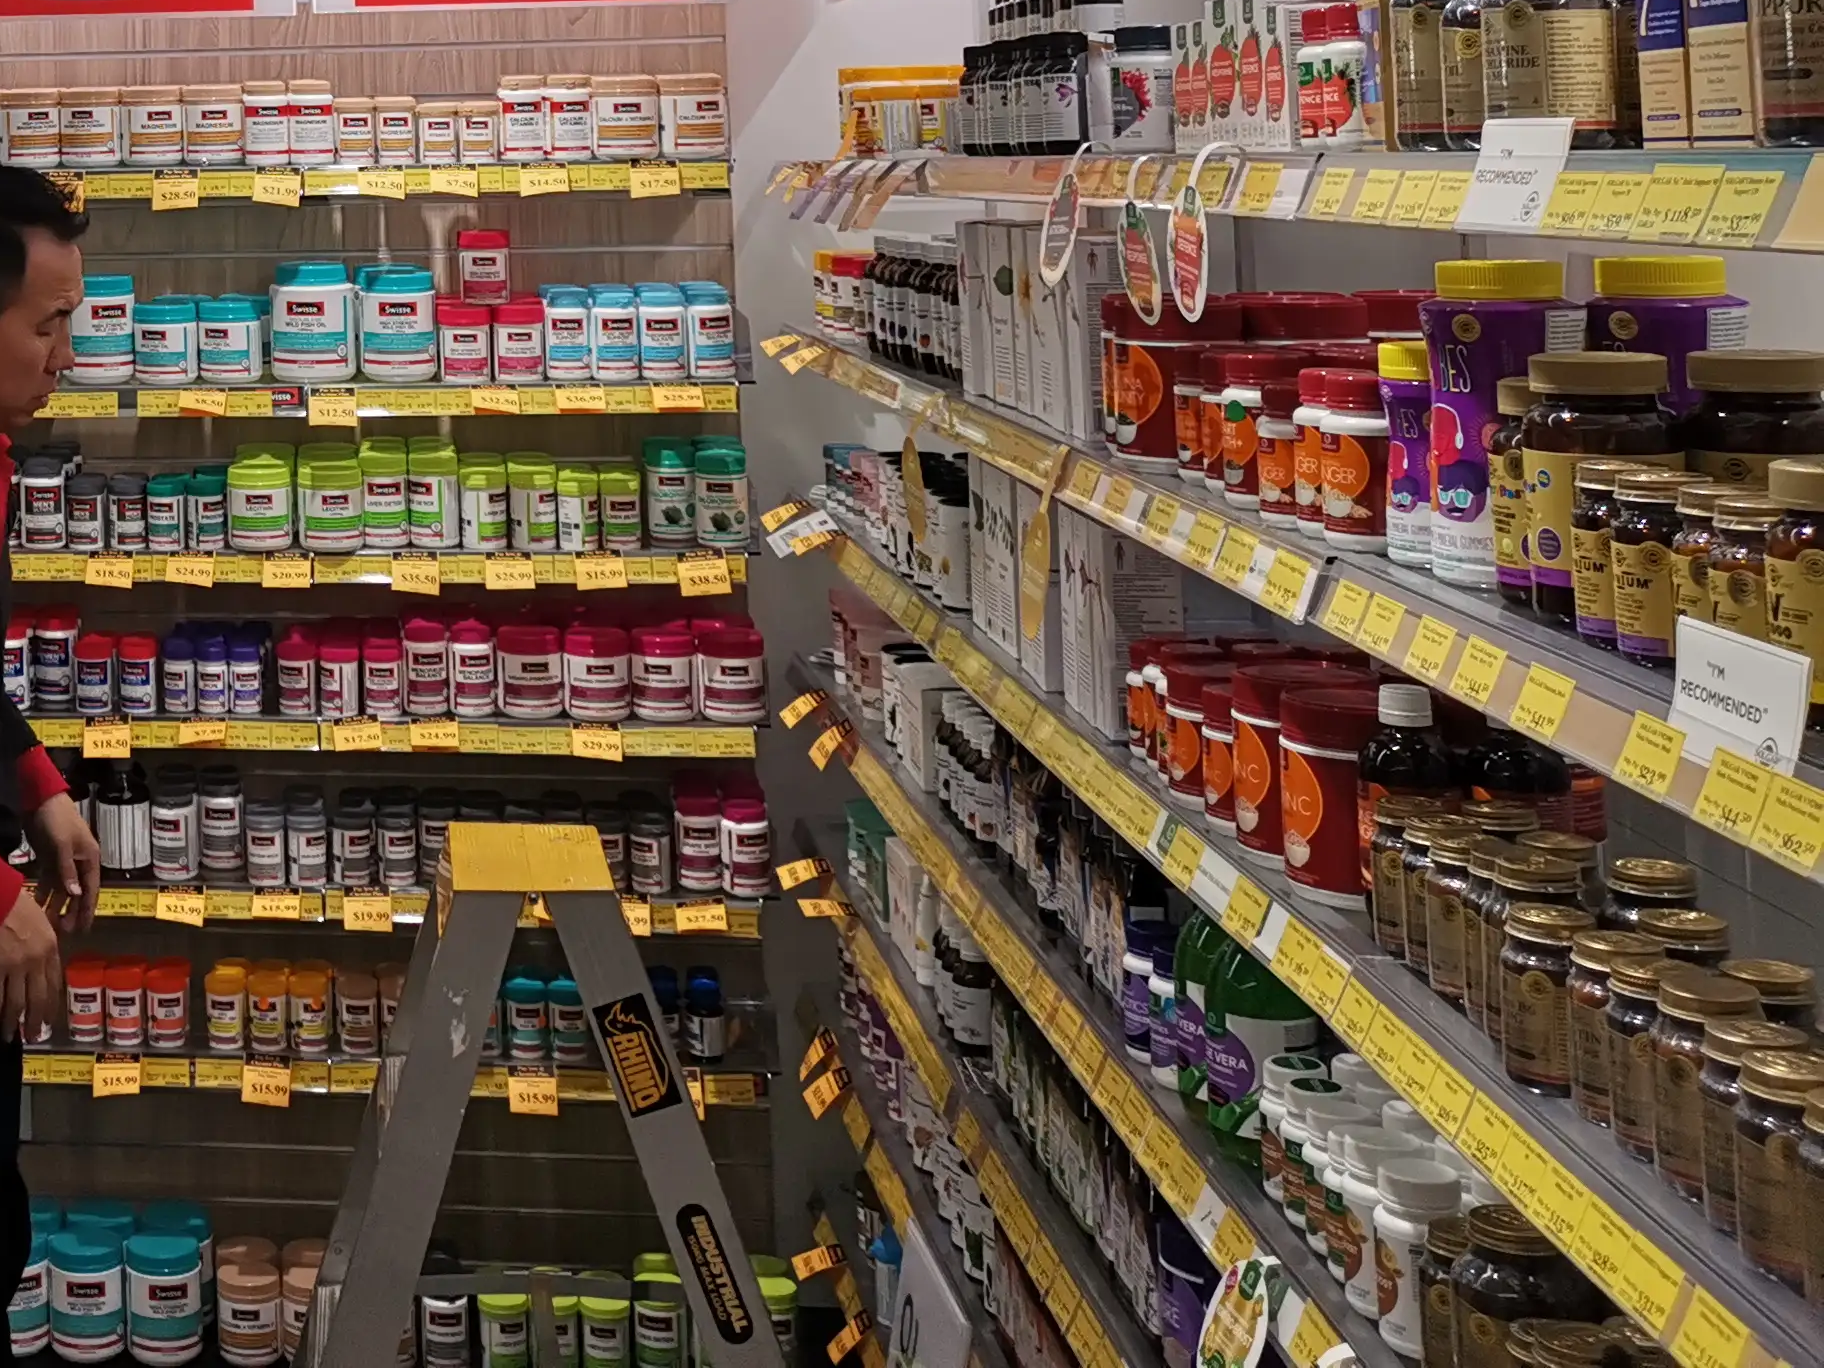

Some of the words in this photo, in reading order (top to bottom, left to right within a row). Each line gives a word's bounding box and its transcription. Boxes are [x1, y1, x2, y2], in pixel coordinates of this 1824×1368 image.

[262, 186, 298, 198] $21.99
[366, 180, 403, 192] $12.50
[160, 190, 197, 202] $28.50
[97, 307, 123, 317] Swisse
[291, 304, 320, 315] Swisse
[384, 304, 412, 315] Swisse
[319, 408, 355, 419] $12.50
[1321, 463, 1357, 484] NGER
[94, 569, 131, 581] $18.50
[175, 567, 212, 579] $24.99
[92, 738, 129, 749] $18.50
[581, 740, 621, 751] $29.99
[1779, 831, 1817, 859] $62.50
[164, 903, 202, 917] $23.99
[352, 911, 390, 923] $19.99
[613, 1031, 662, 1109] RHINO
[101, 1076, 138, 1087] $15.99
[251, 1083, 288, 1097] $15.99
[691, 1215, 749, 1334] INDUSTRIAL
